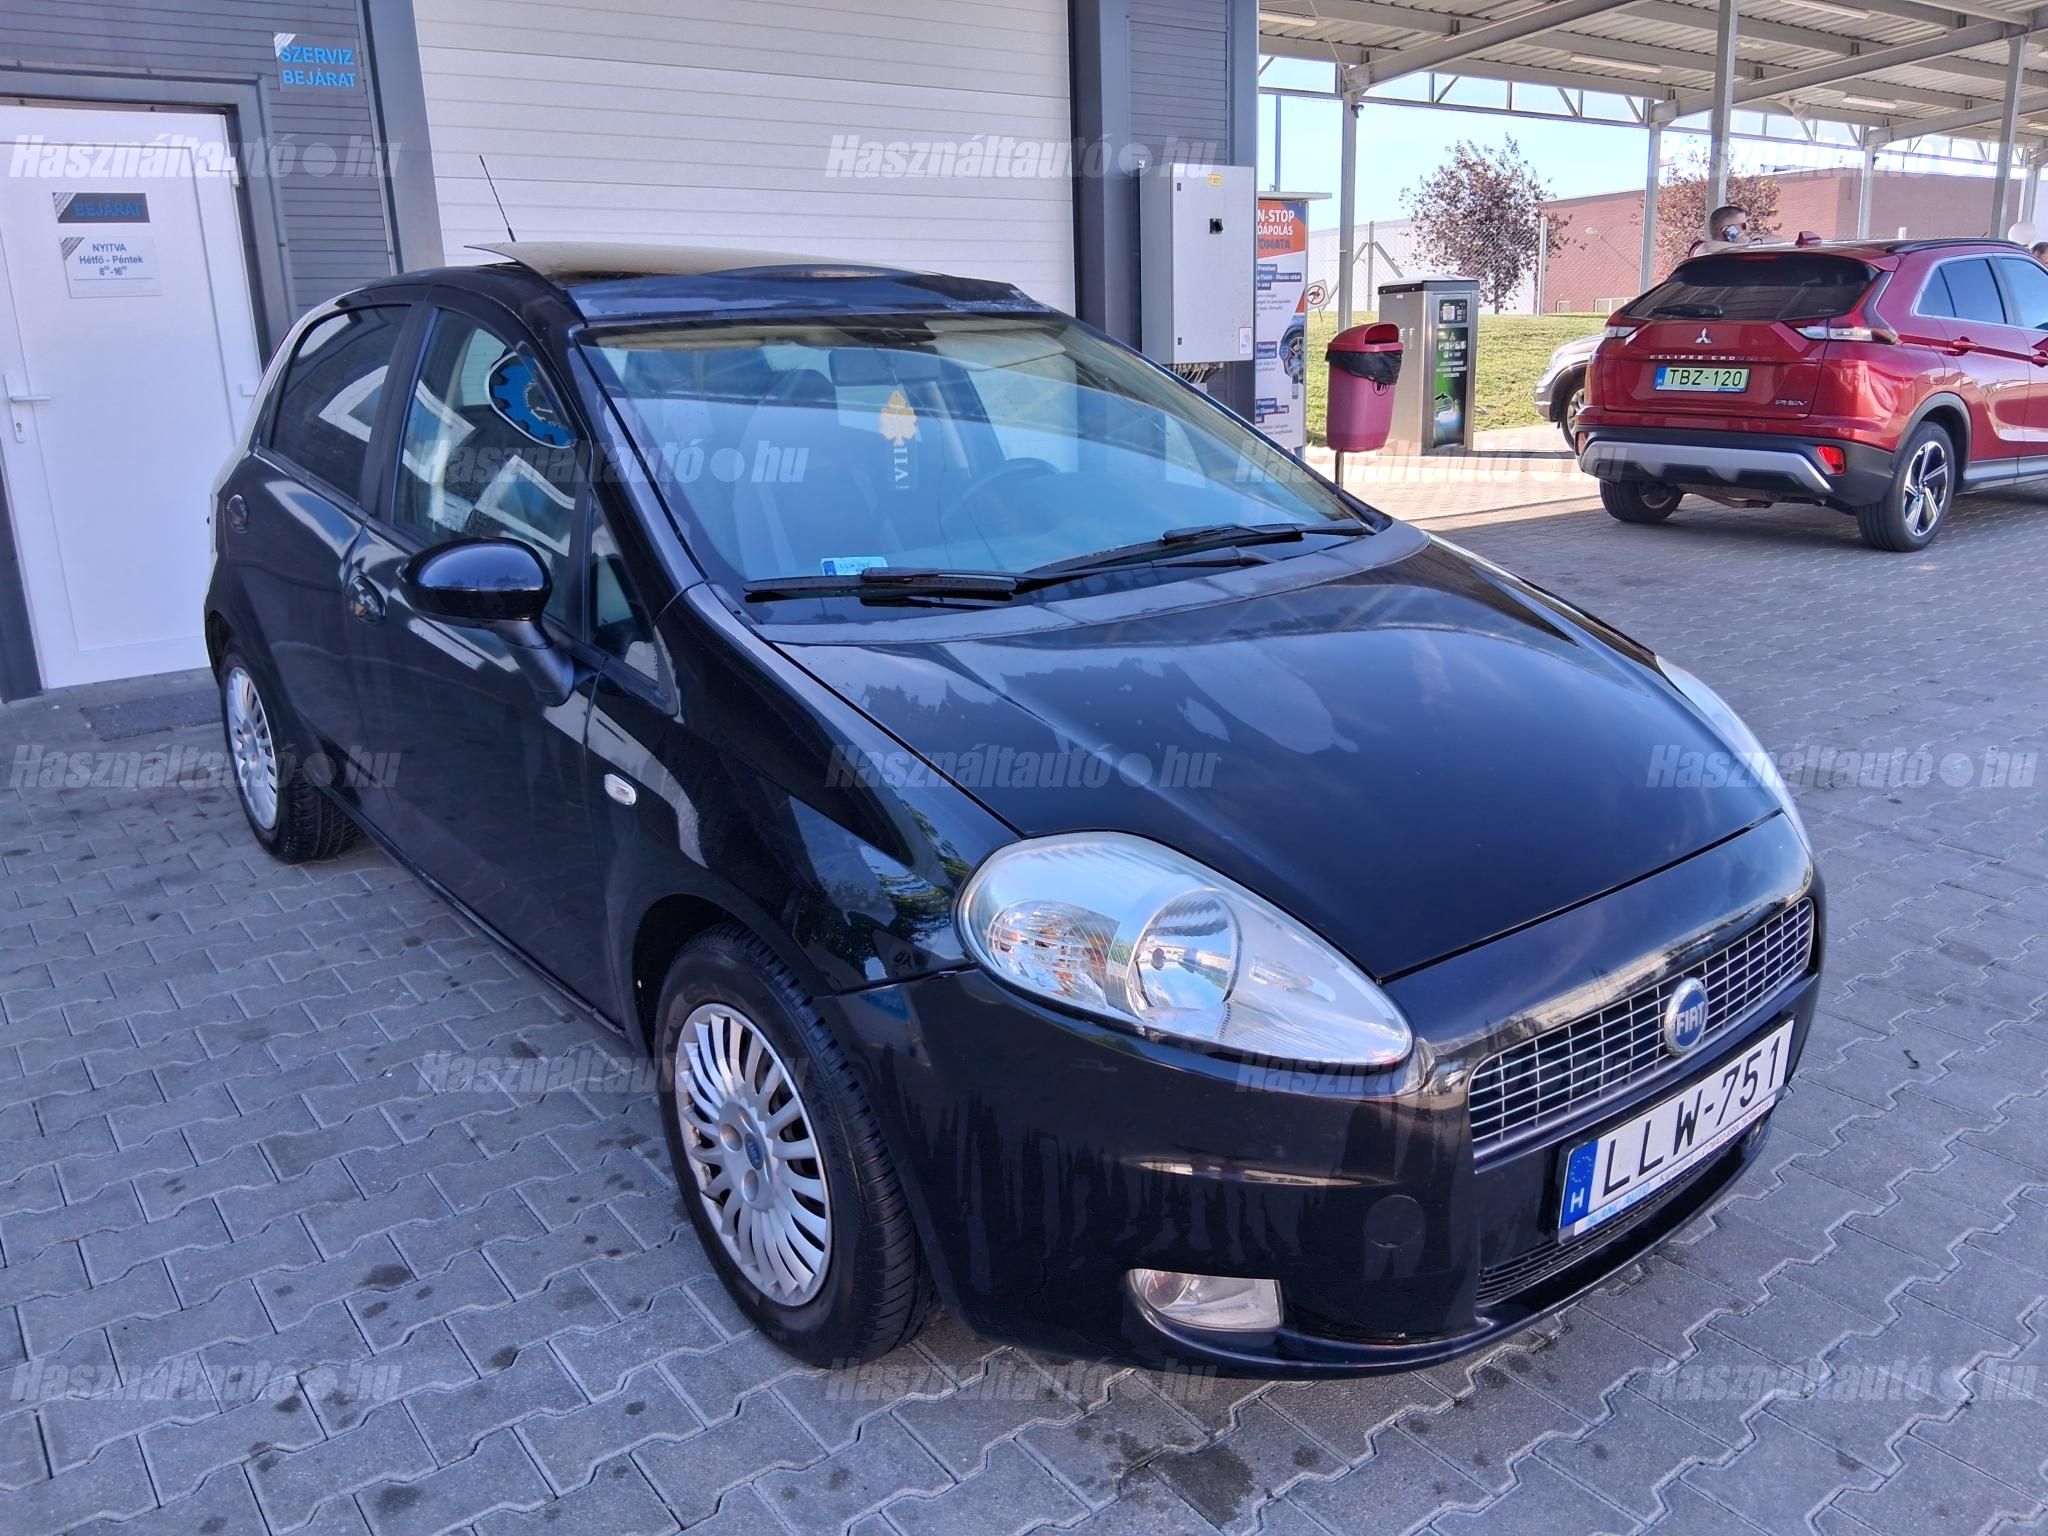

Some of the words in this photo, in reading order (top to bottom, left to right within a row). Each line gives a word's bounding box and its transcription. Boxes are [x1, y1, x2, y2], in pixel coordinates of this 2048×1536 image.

[280, 46, 354, 65] SZERVIZ
[282, 68, 356, 87] BEJÁRAT
[74, 199, 141, 217] BEJÁRAT
[92, 243, 127, 252] NYITVA
[112, 255, 143, 264] Péntek
[1669, 369, 1743, 387] TBZ-120
[1676, 1001, 1704, 1036] FIAT
[1602, 1035, 1781, 1198] LLW-751
[1570, 1187, 1585, 1213] H
